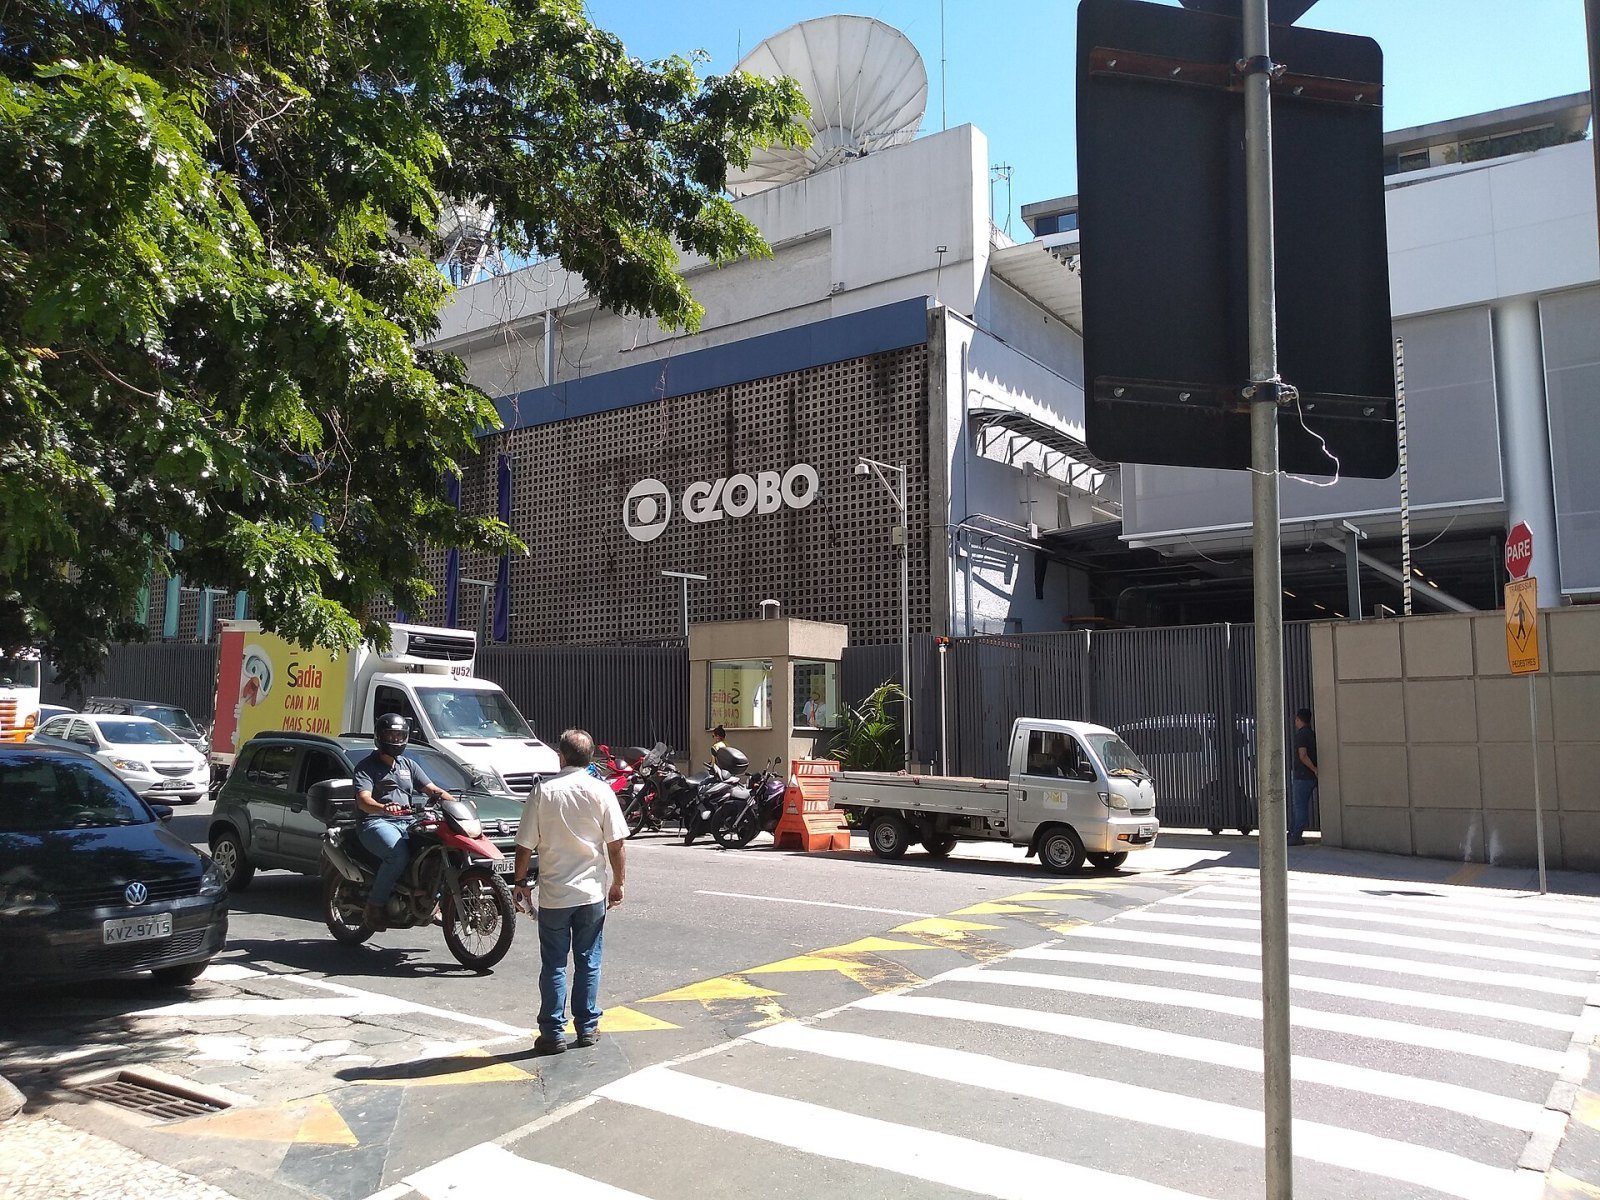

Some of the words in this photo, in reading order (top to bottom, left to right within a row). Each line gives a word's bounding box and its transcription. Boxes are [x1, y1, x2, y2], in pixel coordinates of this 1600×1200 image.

[682, 463, 819, 523] GLOBO
[1506, 538, 1531, 563] PARE
[1511, 657, 1537, 668] PEDESTRES
[287, 662, 322, 688] Sadia
[284, 694, 304, 710] CADA
[307, 695, 320, 711] DIA
[282, 716, 304, 732] MAIS
[305, 717, 332, 734] SADIA.
